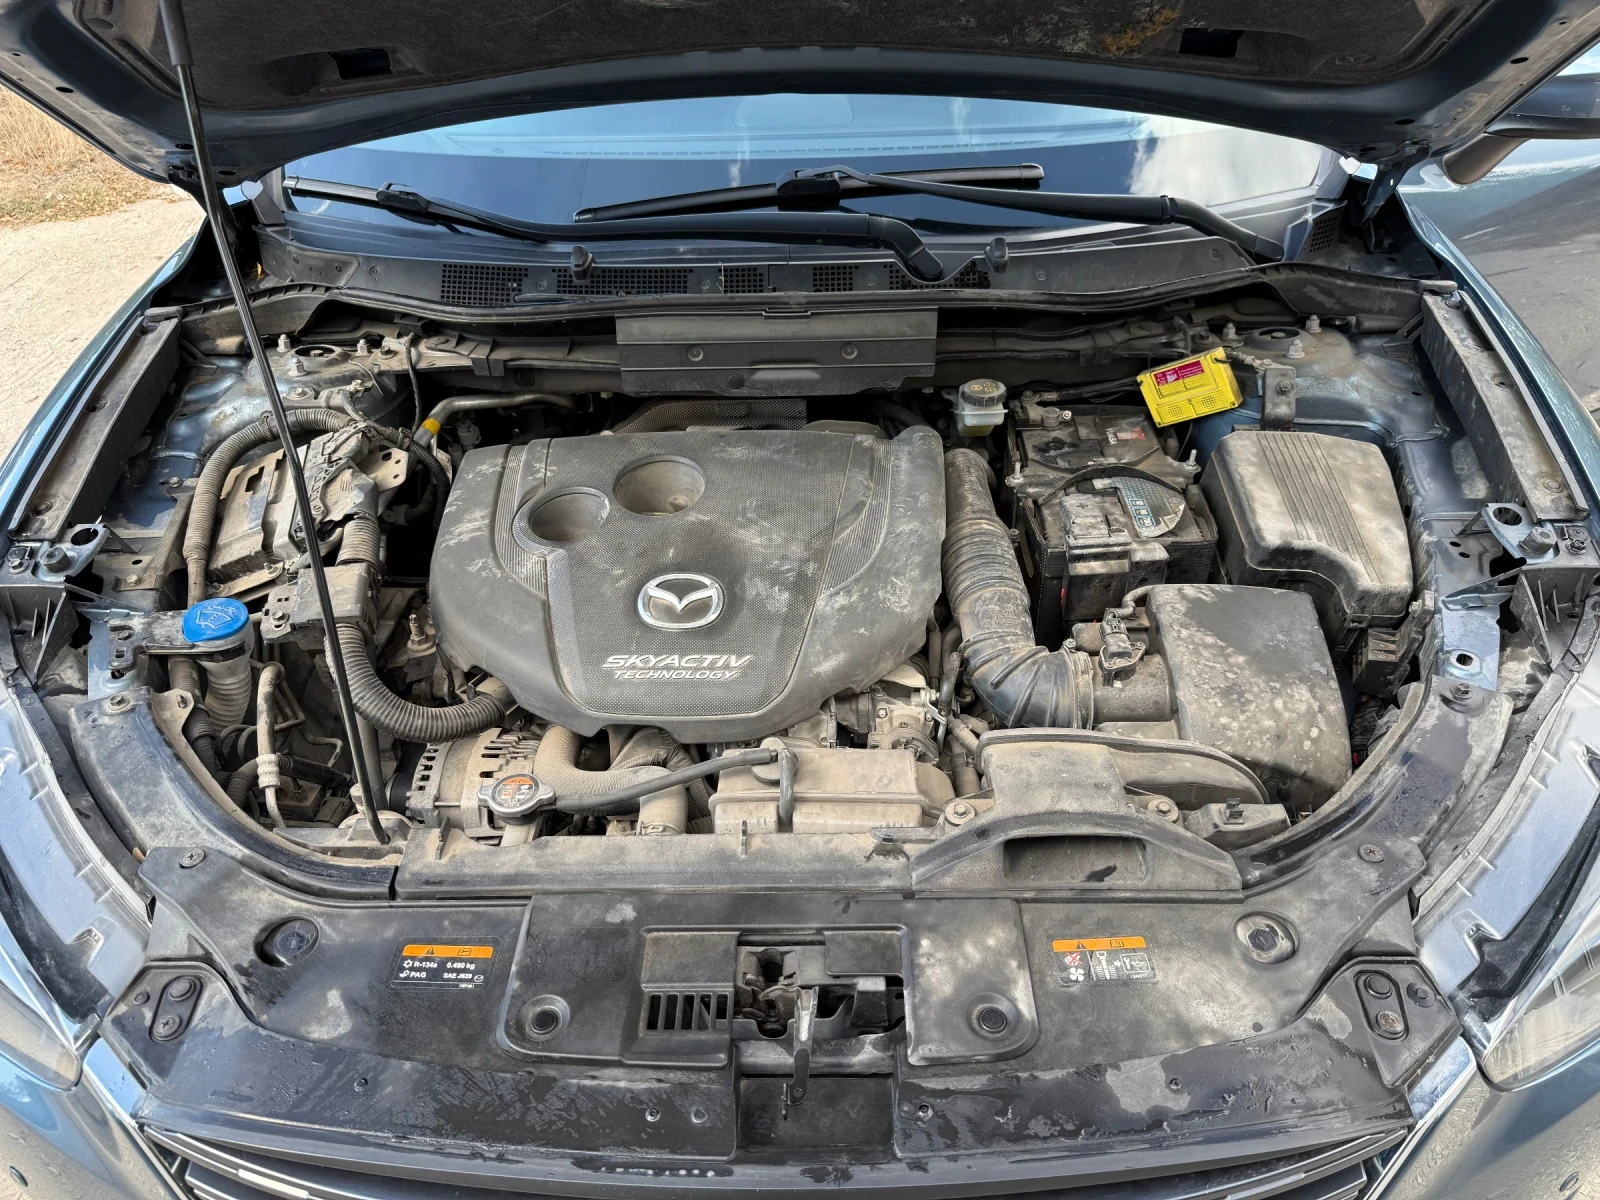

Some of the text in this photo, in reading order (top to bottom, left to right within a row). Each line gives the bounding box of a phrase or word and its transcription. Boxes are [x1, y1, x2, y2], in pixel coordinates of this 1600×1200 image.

[602, 654, 754, 669] SKYACTIV
[614, 670, 738, 680] TECHNOLOGY
[466, 962, 476, 970] kg
